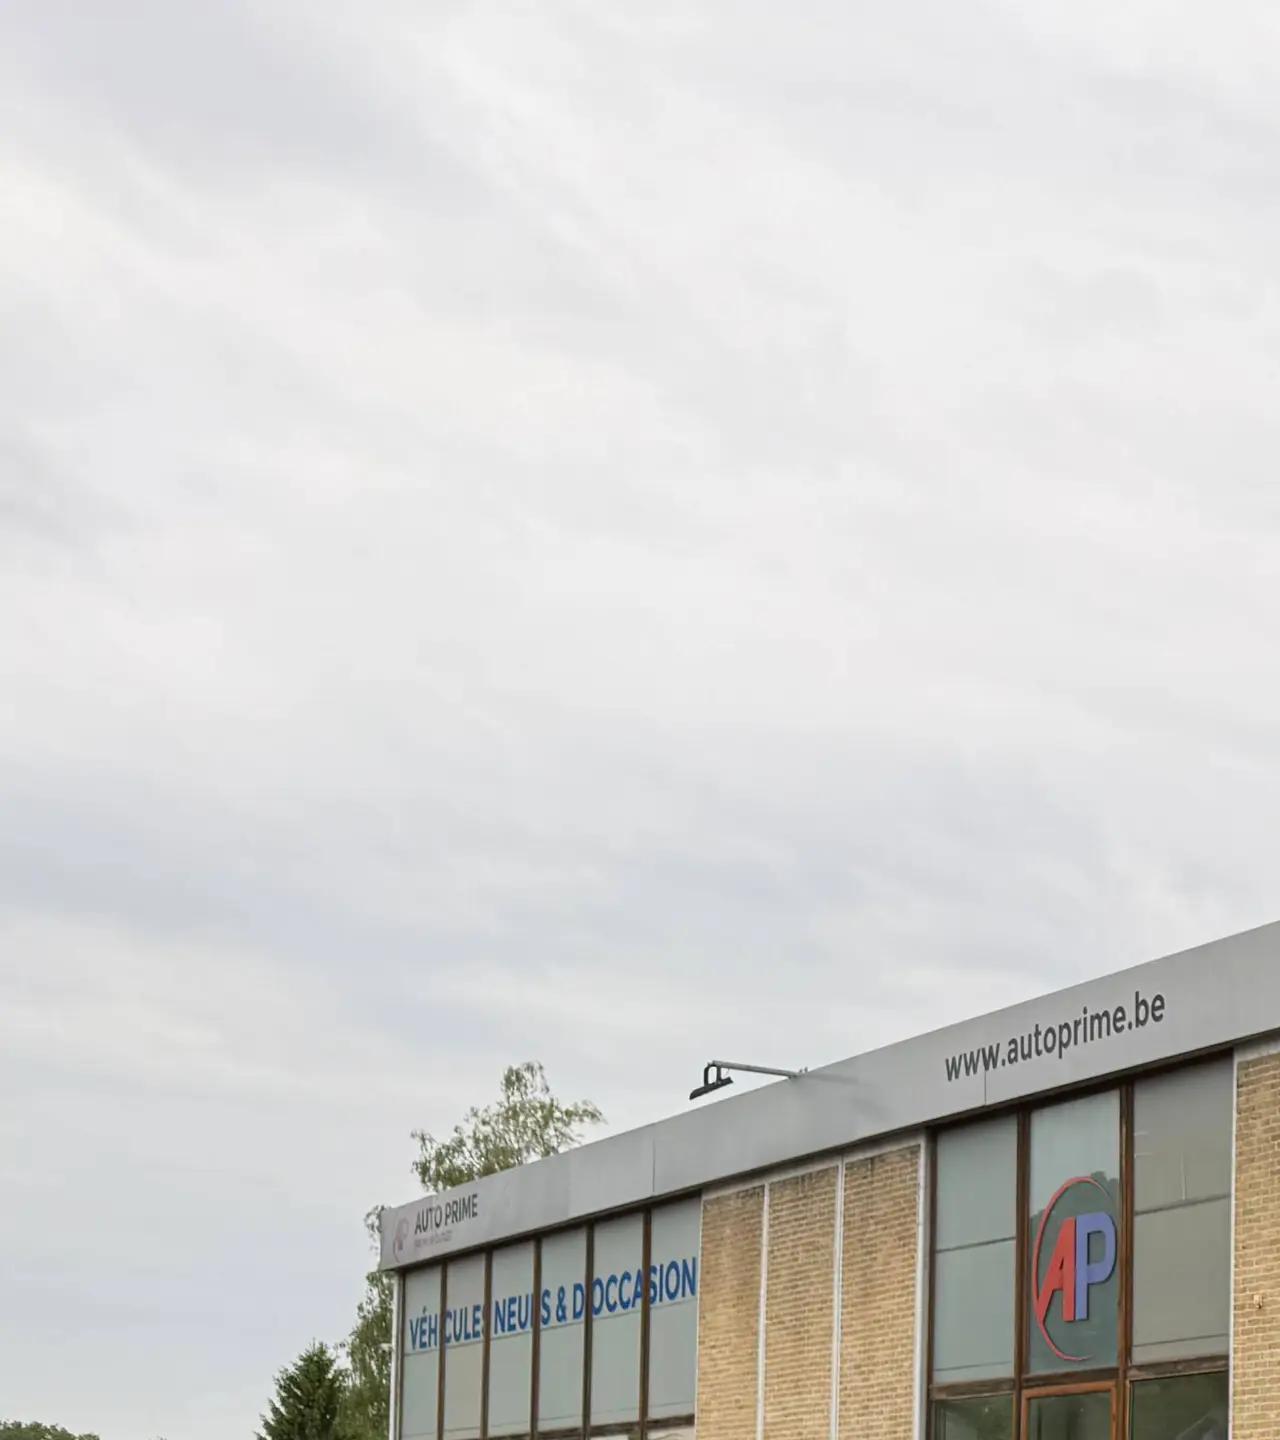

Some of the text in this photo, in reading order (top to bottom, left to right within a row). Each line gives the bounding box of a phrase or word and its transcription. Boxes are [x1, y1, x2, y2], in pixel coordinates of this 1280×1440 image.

[944, 990, 1166, 1083] www.autoprime.be
[414, 1193, 479, 1235] AUTO PRIME
[1038, 1211, 1118, 1324] AP
[409, 1304, 486, 1351] VÉHCULE
[494, 1288, 552, 1335] NEUS
[555, 1284, 568, 1323] &
